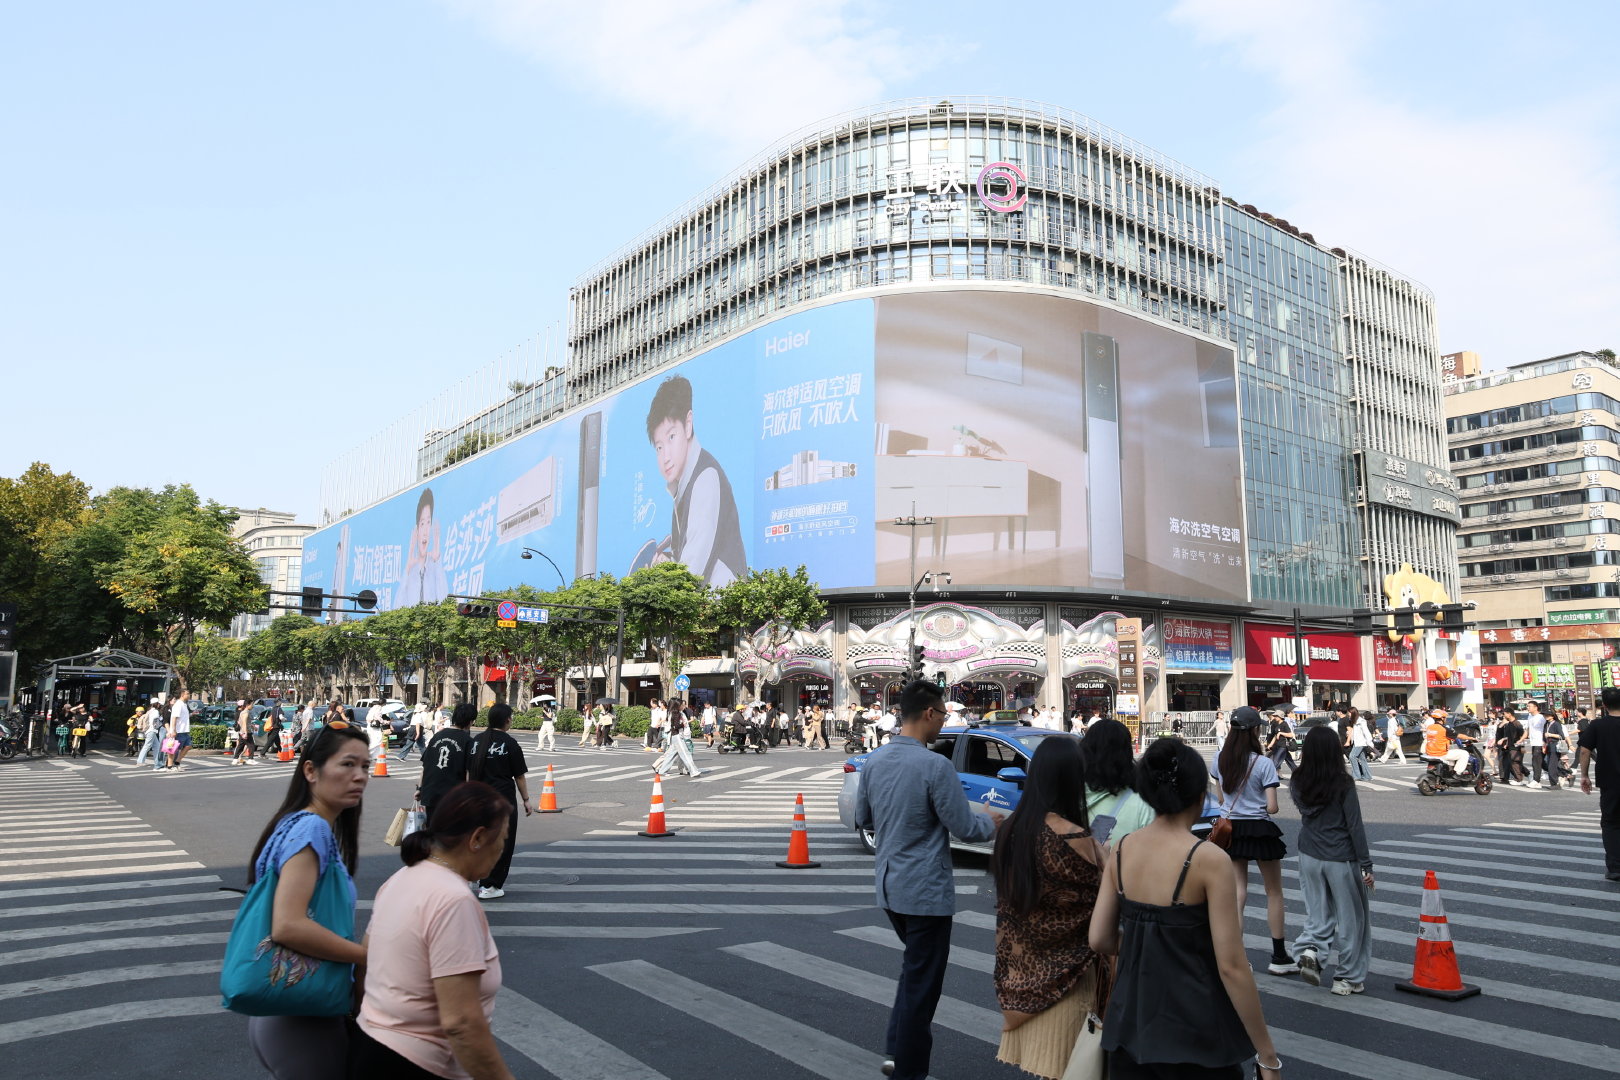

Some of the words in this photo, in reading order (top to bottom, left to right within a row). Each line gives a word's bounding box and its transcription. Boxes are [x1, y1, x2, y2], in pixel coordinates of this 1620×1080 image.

[883, 163, 964, 199] 工联
[765, 329, 811, 357] Haier
[763, 373, 862, 414] 海尔舒适风空调
[761, 407, 802, 439] 只吹风
[808, 397, 859, 427] 不吹人
[1169, 516, 1241, 543] 海尔洗空气空调
[1310, 646, 1340, 660] 無印良品
